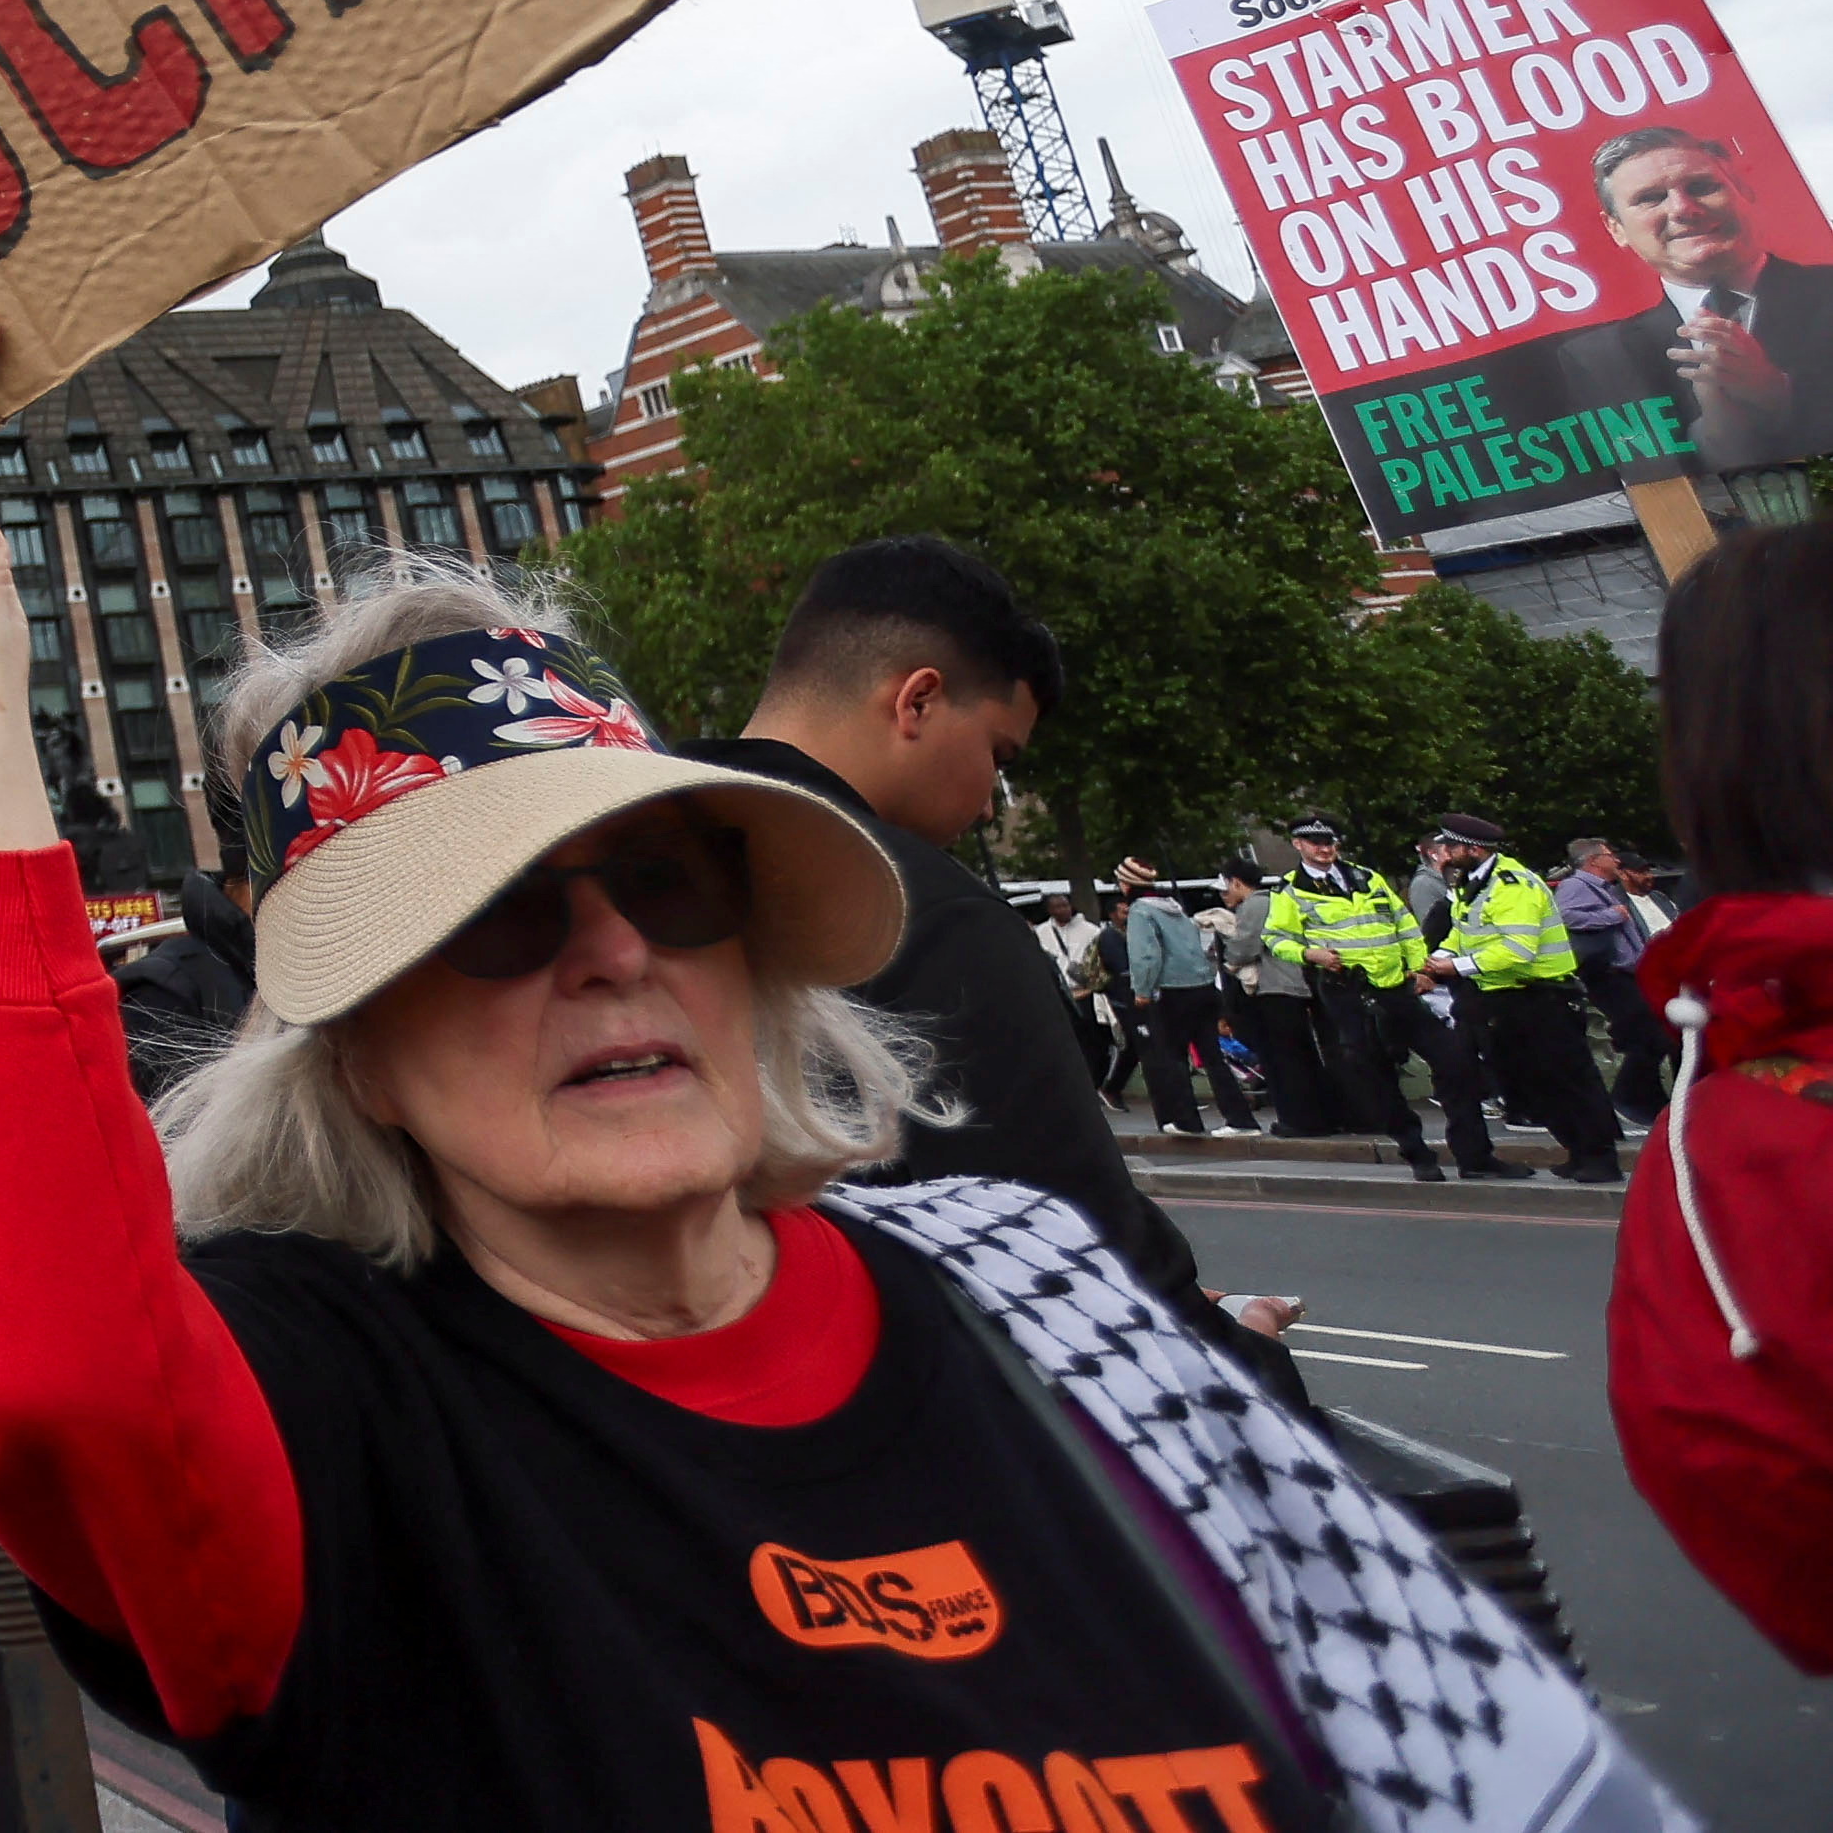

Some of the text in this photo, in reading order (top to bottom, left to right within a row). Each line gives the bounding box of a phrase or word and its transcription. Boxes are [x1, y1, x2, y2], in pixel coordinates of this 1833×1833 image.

[1238, 22, 1712, 212] HAS BLOOD
[1279, 147, 1561, 288] ON HIS
[1310, 231, 1599, 373] HANDS
[1354, 374, 1506, 456] FREE
[1379, 395, 1697, 514] PALESTINE
[769, 1552, 936, 1642] BDS
[926, 1588, 991, 1620] FRANCE
